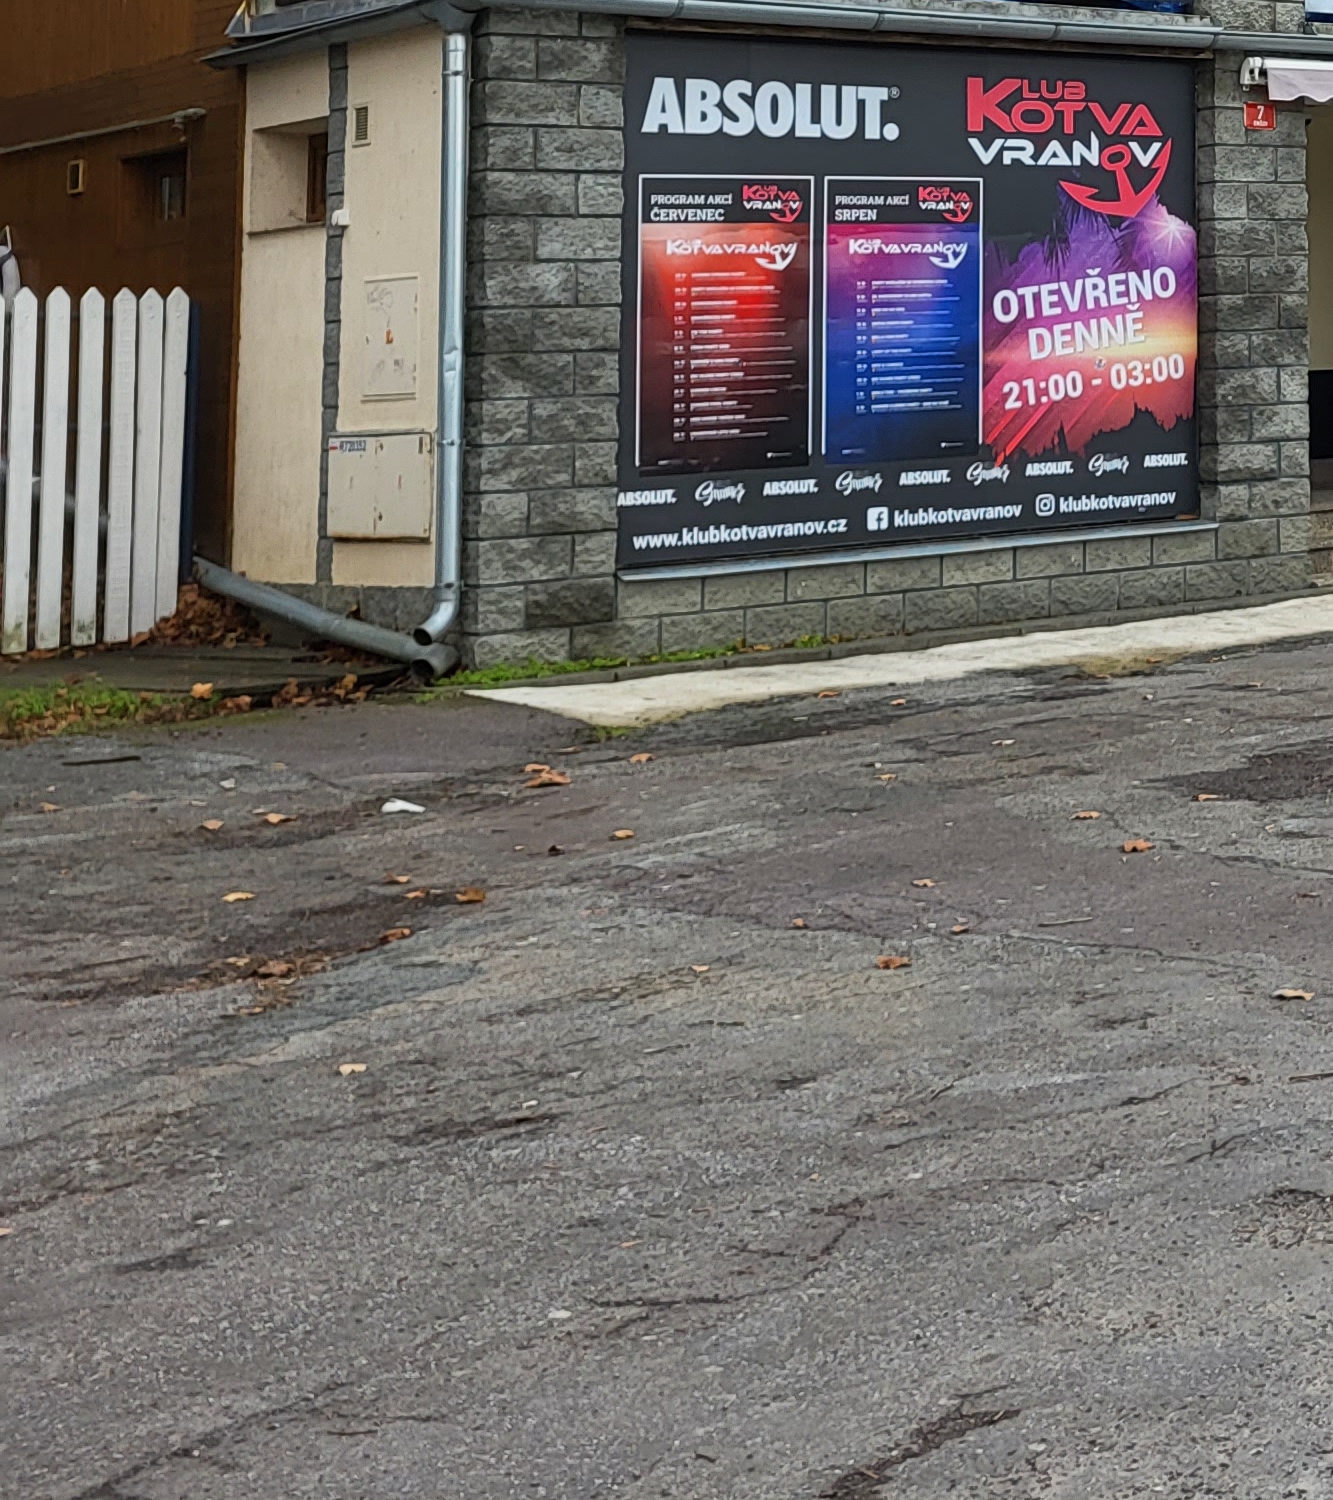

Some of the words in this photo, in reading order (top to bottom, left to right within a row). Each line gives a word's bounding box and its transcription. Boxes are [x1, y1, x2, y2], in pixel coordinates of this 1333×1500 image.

[967, 77, 1163, 136] KOTVA
[1257, 105, 1265, 119] 7
[967, 130, 1163, 171] VRANOV
[650, 195, 705, 205] PROGRAM
[706, 192, 732, 205] AKCÍ
[650, 206, 725, 221] ČERVENEC
[834, 208, 878, 221] SRPEN
[835, 195, 884, 205] PROGRAM
[886, 193, 909, 205] AKCÍ
[993, 266, 1176, 323] OTEVŘENO
[1028, 303, 1146, 360] DENNĚ
[1002, 370, 1084, 410] 21:00
[1110, 353, 1185, 390] 03:00
[632, 517, 849, 551] www.klubkotvavranov.cz
[893, 503, 1023, 528] klubkotvavranov
[1059, 491, 1177, 514] klubkotvavranov
